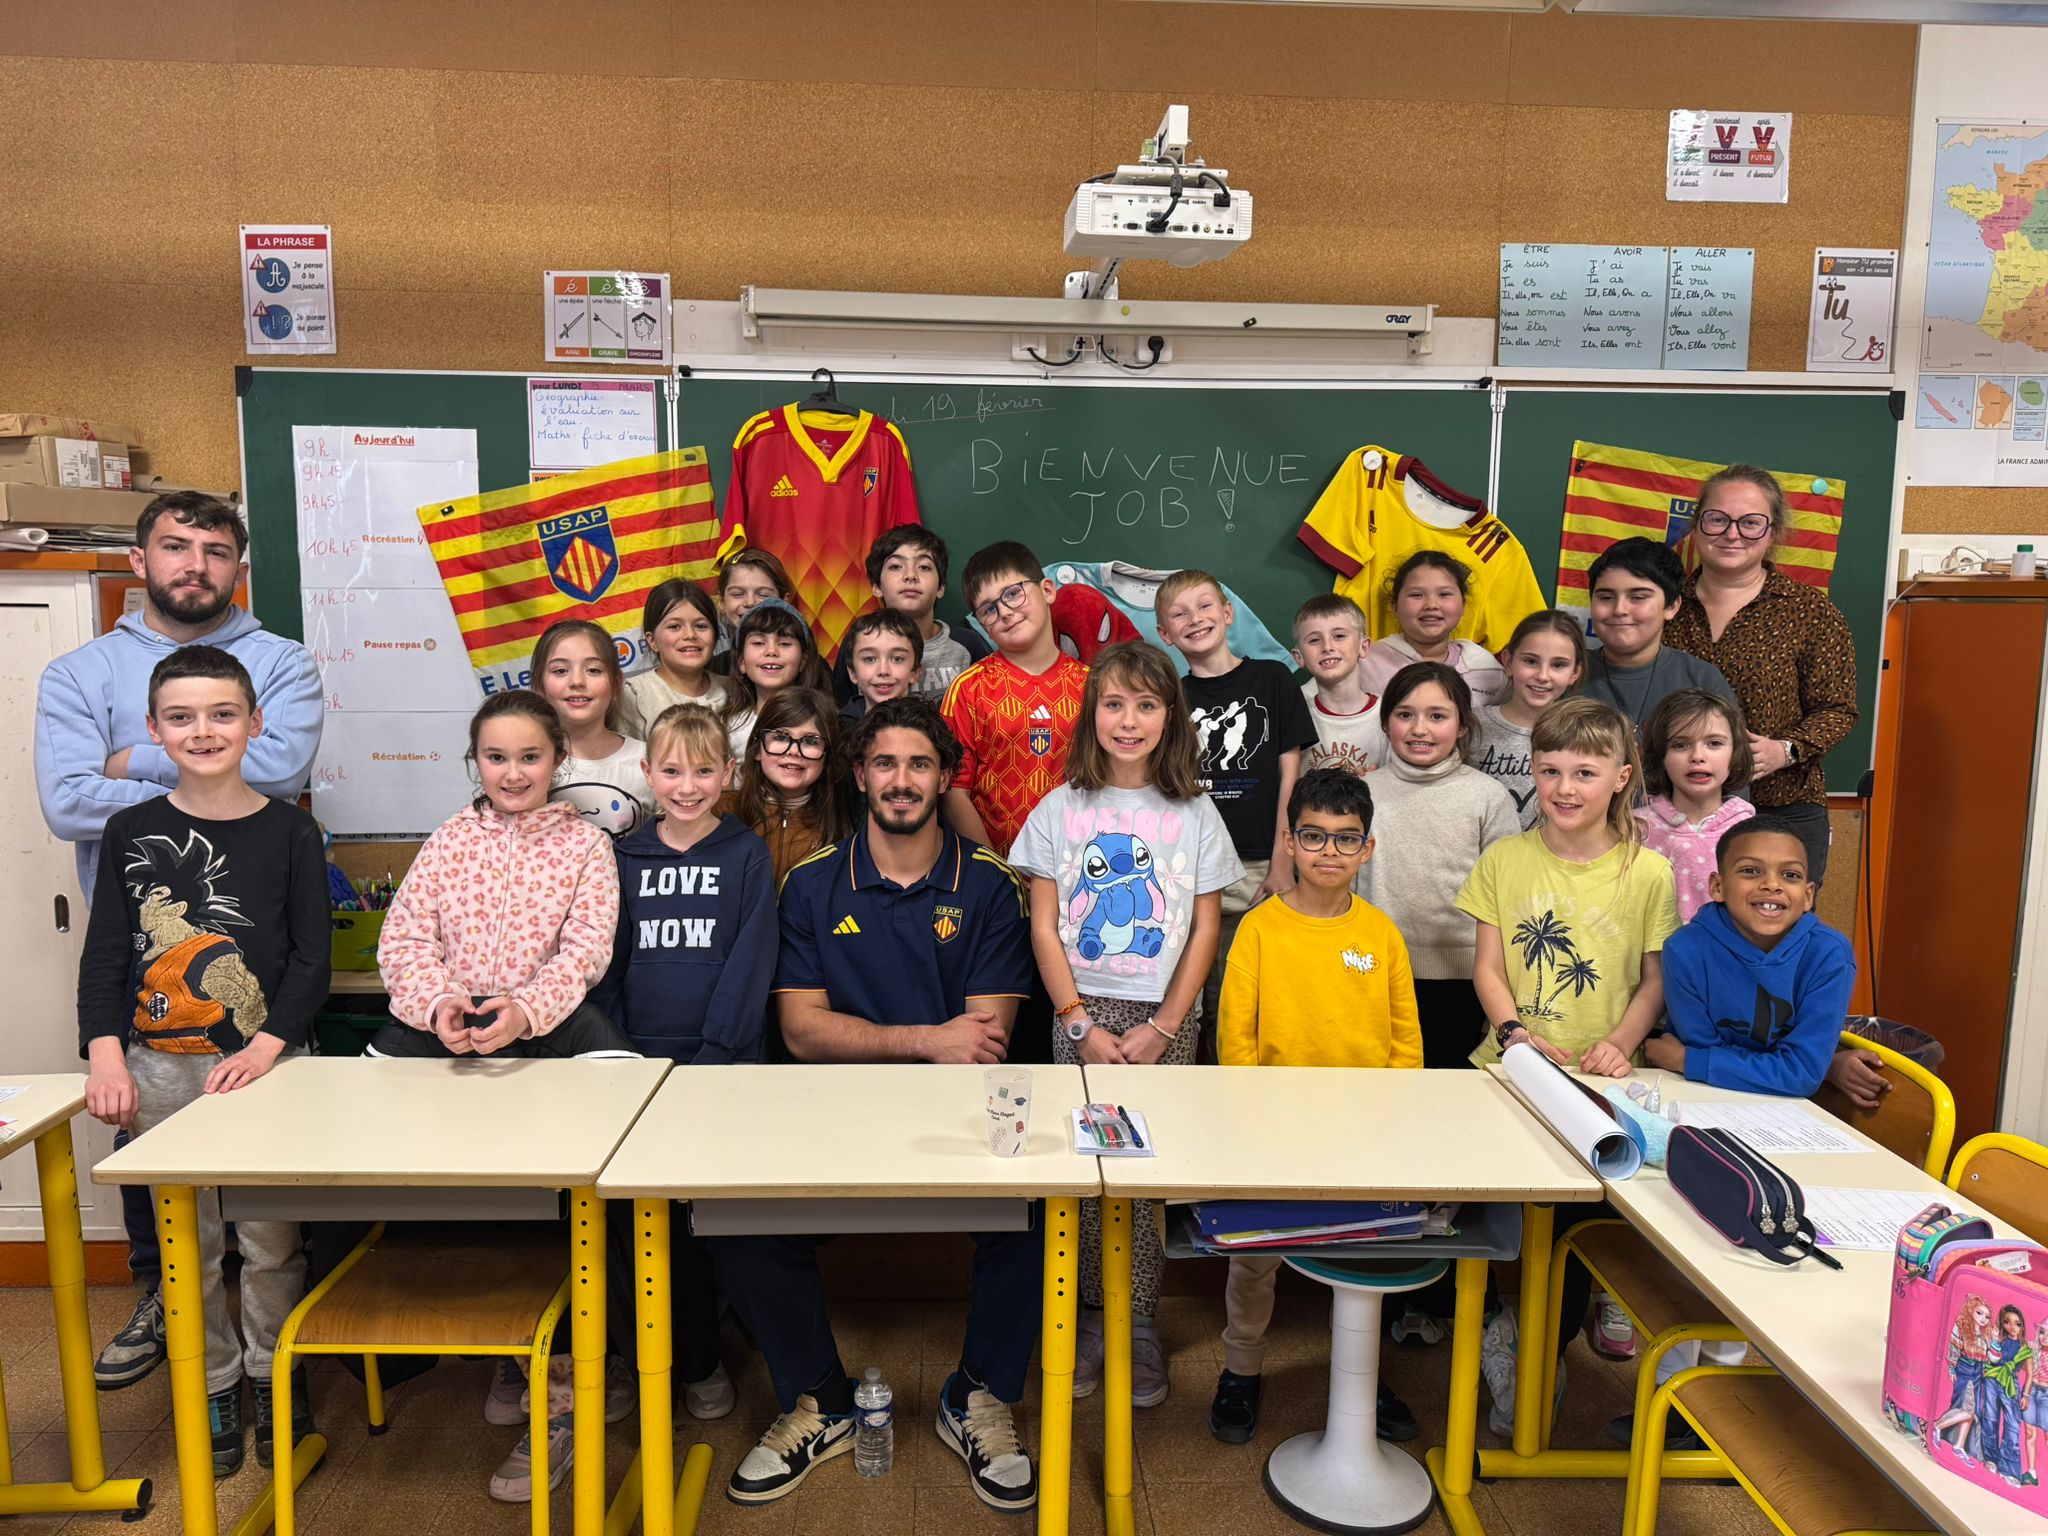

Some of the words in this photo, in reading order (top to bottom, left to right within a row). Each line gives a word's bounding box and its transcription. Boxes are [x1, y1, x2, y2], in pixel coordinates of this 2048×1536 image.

[257, 238, 270, 246] LA
[273, 238, 315, 246] PHRASE
[1523, 244, 1550, 254] ÊTRE
[1695, 248, 1727, 258] ALLER
[1503, 260, 1513, 272] Je
[1524, 258, 1549, 268] suis
[1672, 261, 1683, 274] Je
[1690, 264, 1711, 272] vais
[1502, 277, 1514, 288] Tu
[1523, 278, 1536, 286] es
[1587, 274, 1599, 284] Tu
[1672, 275, 1683, 285] Tu
[1689, 277, 1708, 286] vas
[1550, 289, 1568, 300] est
[1818, 284, 1849, 320] Tu
[1501, 308, 1519, 317] Nous
[1525, 308, 1566, 317] sommes
[1584, 306, 1603, 316] Nous
[1670, 305, 1692, 317] Nous
[1701, 306, 1733, 317] allons
[1386, 314, 1412, 324] ORAY
[1501, 321, 1518, 331] Vous
[1526, 321, 1547, 332] êtes
[1583, 323, 1600, 333] Vous
[1607, 326, 1636, 336] avez
[1668, 325, 1690, 336] Vous
[1697, 323, 1730, 340] allez
[1515, 338, 1530, 346] elles
[1535, 337, 1562, 348] sont
[1600, 340, 1618, 348] Elles
[1688, 341, 1706, 350] Elles
[1711, 340, 1737, 350] vont
[619, 383, 650, 392] MARS
[541, 404, 613, 416] évaluation
[619, 408, 640, 416] sur
[922, 393, 956, 420] 19
[975, 389, 1043, 423] février
[354, 434, 415, 446] Aujourd'hui
[582, 427, 612, 449] fiche
[770, 489, 798, 497] adidas
[1674, 501, 1700, 516] US
[1061, 486, 1190, 545] JOB
[542, 509, 604, 536] USAP
[362, 534, 415, 543] Récréation
[364, 640, 393, 649] Pause
[395, 640, 421, 649] repas
[372, 752, 425, 761] Récréation
[1311, 742, 1368, 766] ALASKA
[1064, 807, 1184, 844] WEIRD
[639, 866, 721, 898] LOVE
[936, 907, 960, 915] USAP
[638, 918, 716, 949] NOW
[1341, 949, 1374, 972] NIKE
[1110, 957, 1159, 976] CUTE
